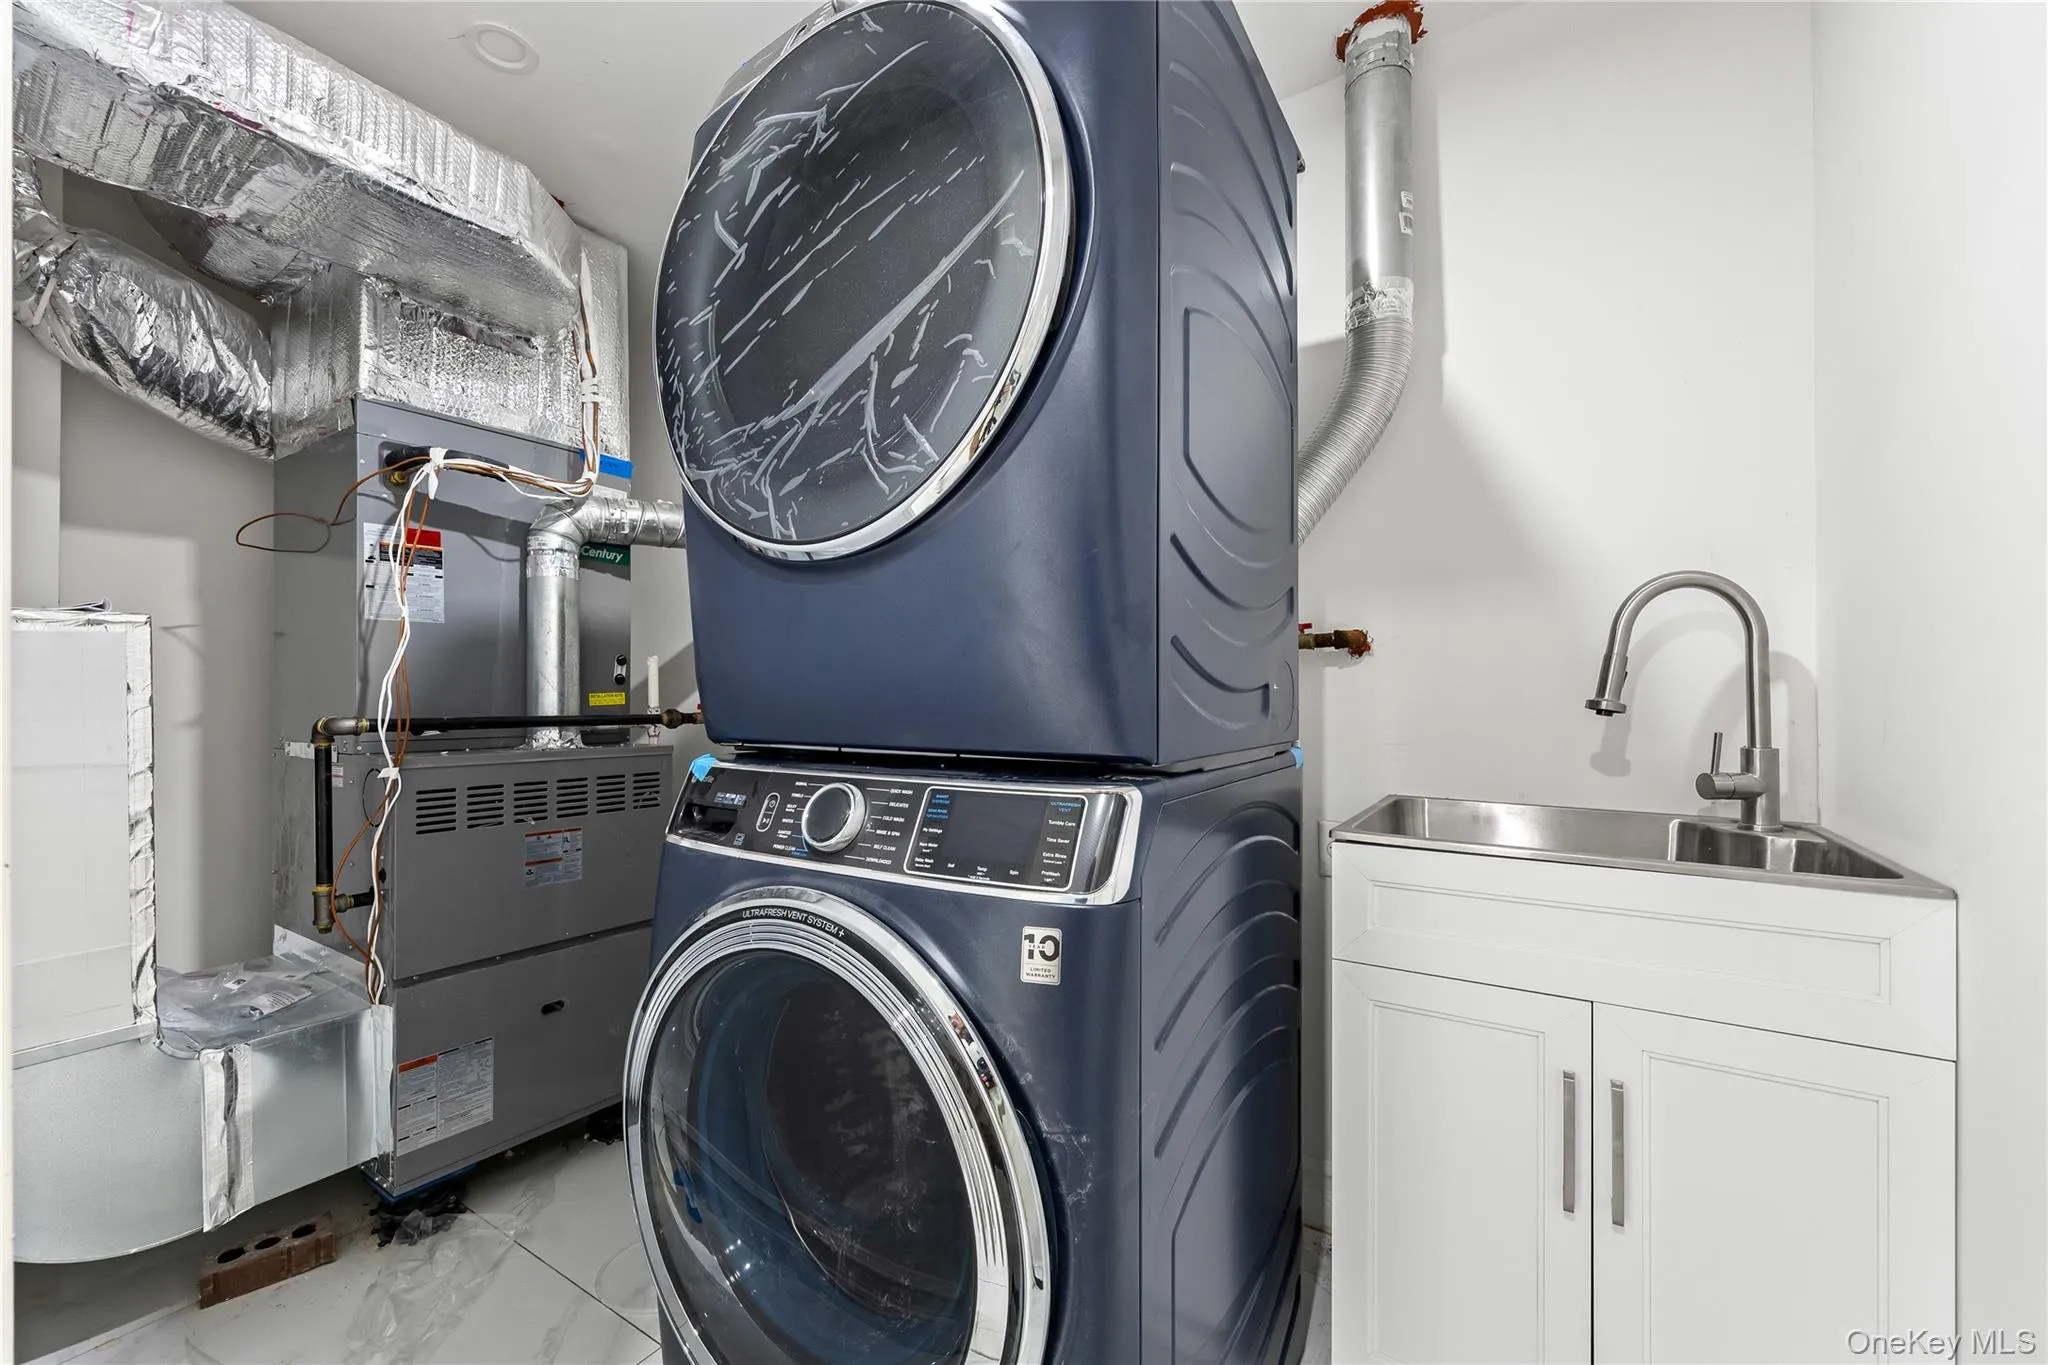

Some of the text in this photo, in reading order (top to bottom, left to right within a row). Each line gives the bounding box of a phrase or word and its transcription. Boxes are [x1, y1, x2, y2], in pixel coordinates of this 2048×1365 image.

[581, 545, 623, 563] Century
[865, 857, 892, 865] DOWNLOADED
[742, 908, 787, 918] ULTRAFRESH
[787, 910, 807, 921] VENT
[807, 915, 838, 934] SYSTEM
[1024, 933, 1060, 962] 10
